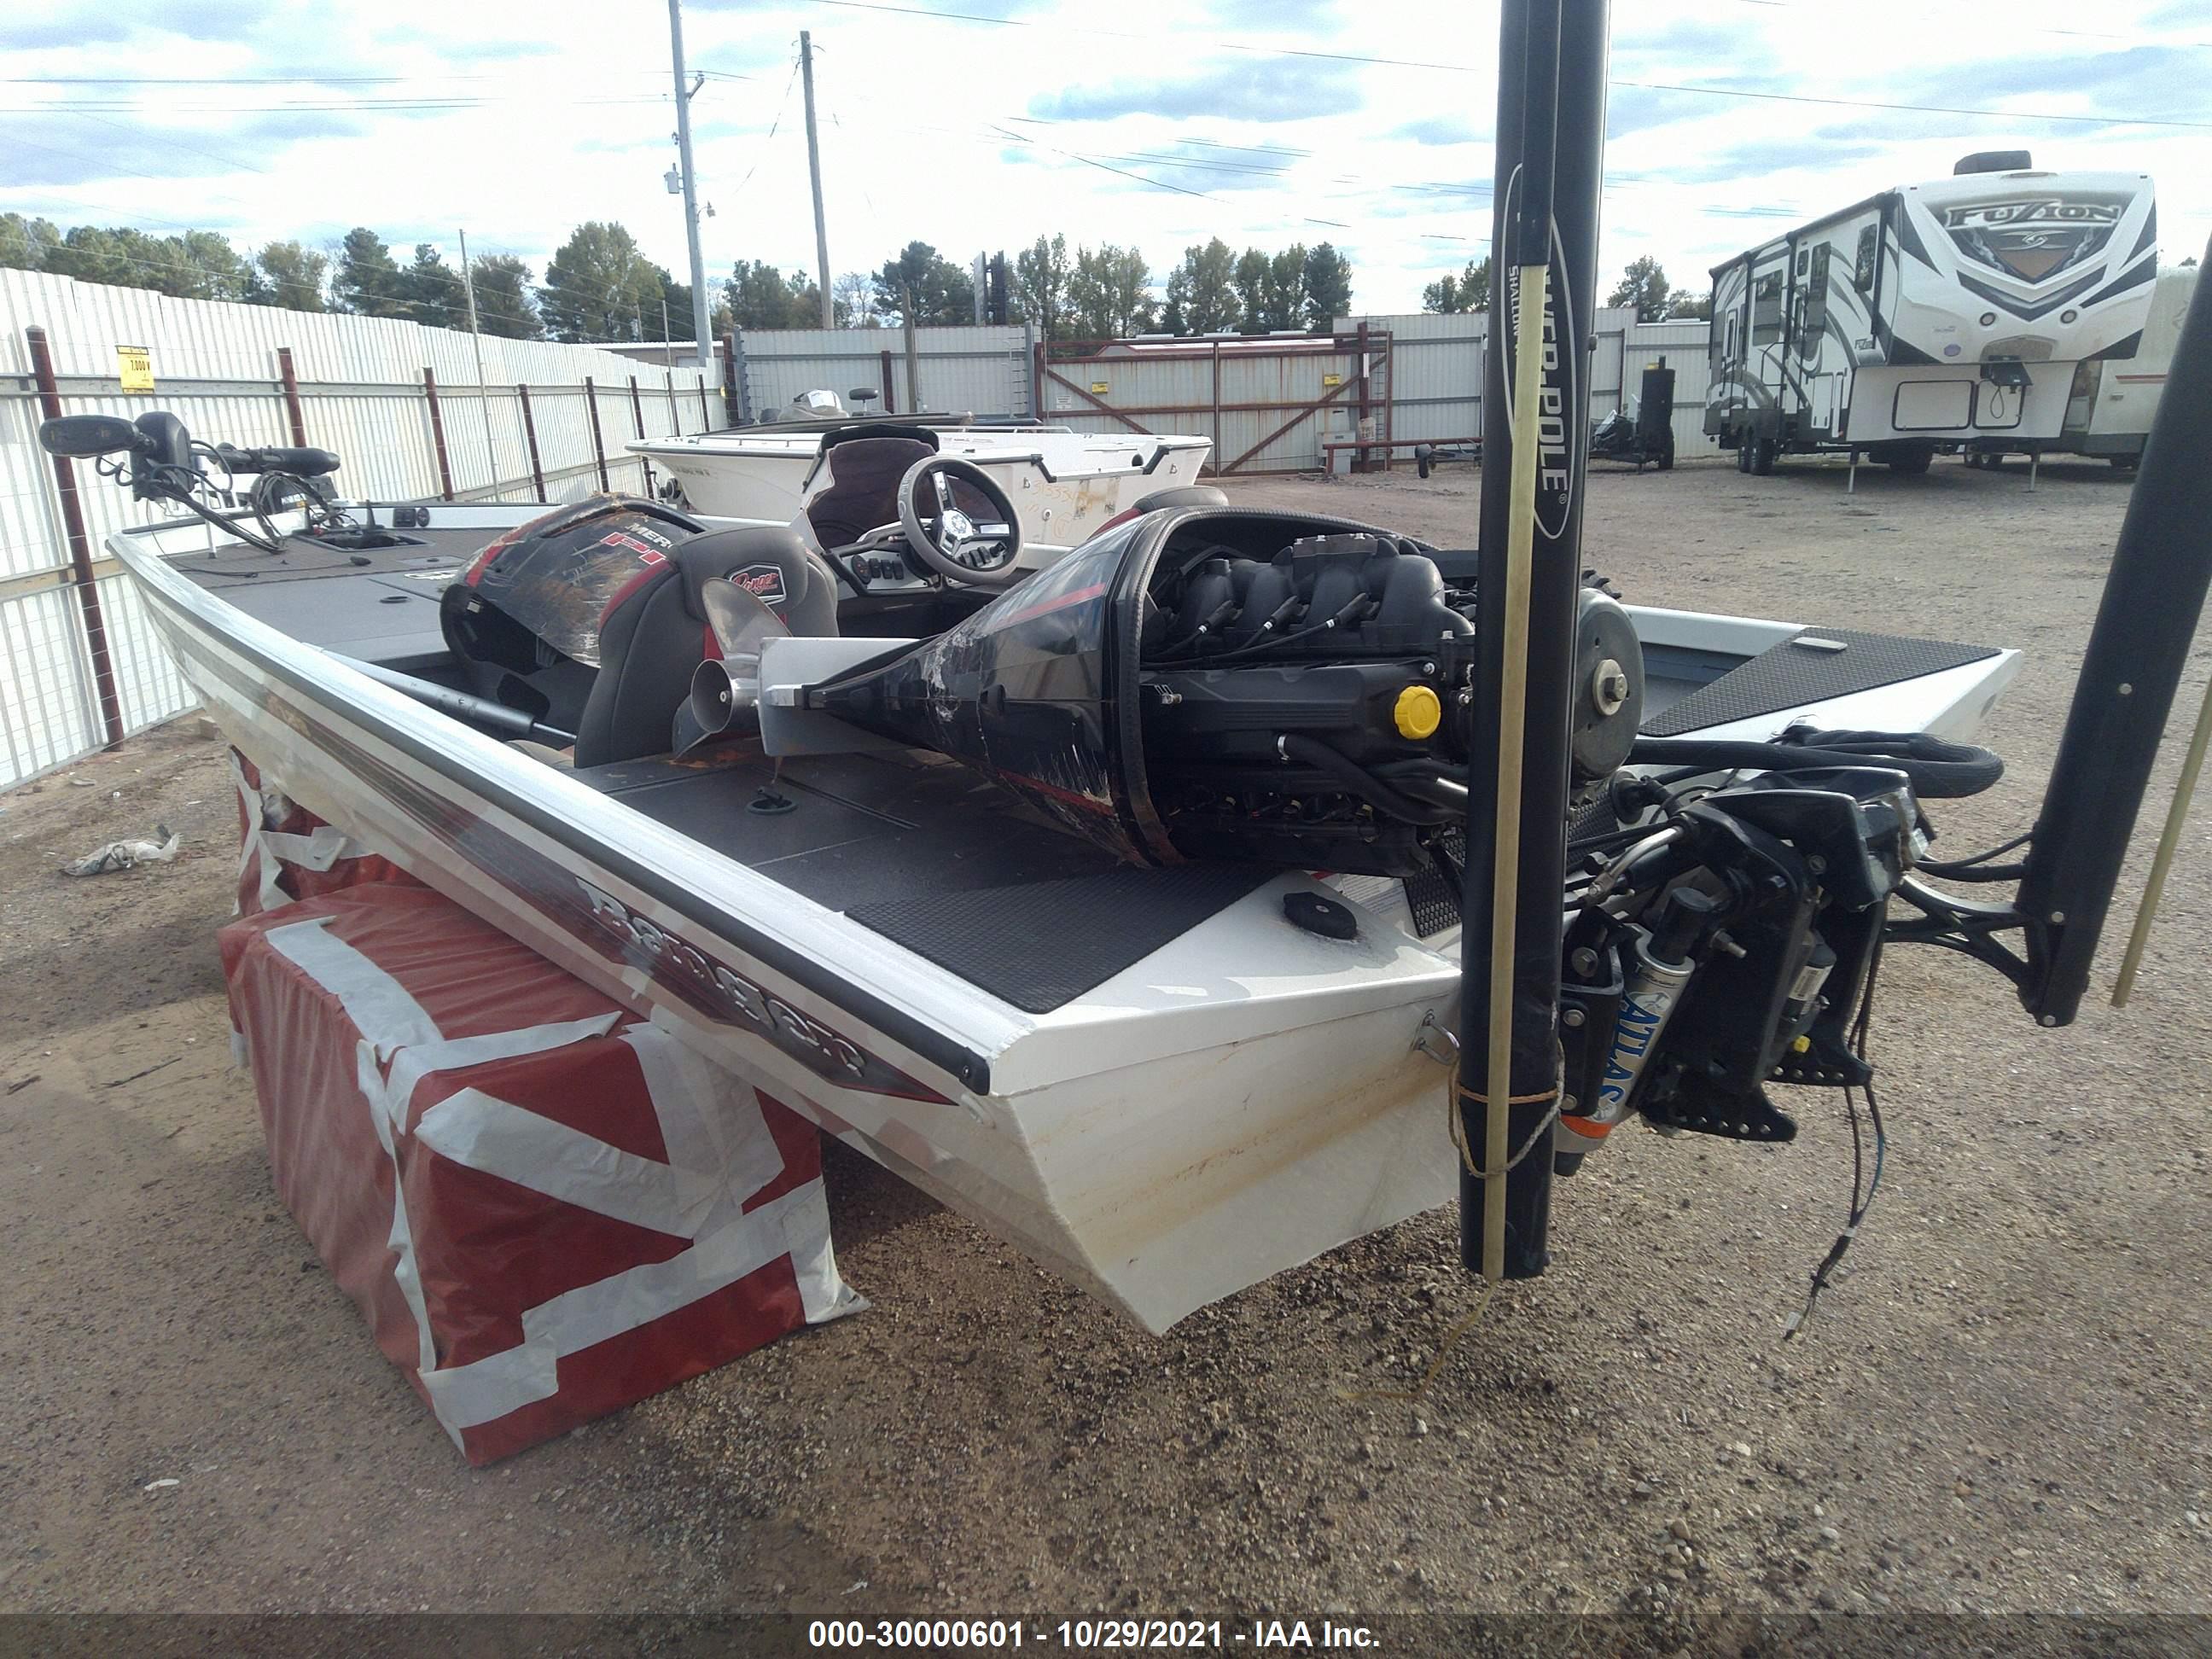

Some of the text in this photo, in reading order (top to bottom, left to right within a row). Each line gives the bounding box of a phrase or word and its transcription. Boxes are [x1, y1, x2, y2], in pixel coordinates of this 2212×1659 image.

[1946, 200, 2122, 230] FUZION
[625, 522, 673, 549] MER
[1598, 995, 1662, 1103] ATLAS
